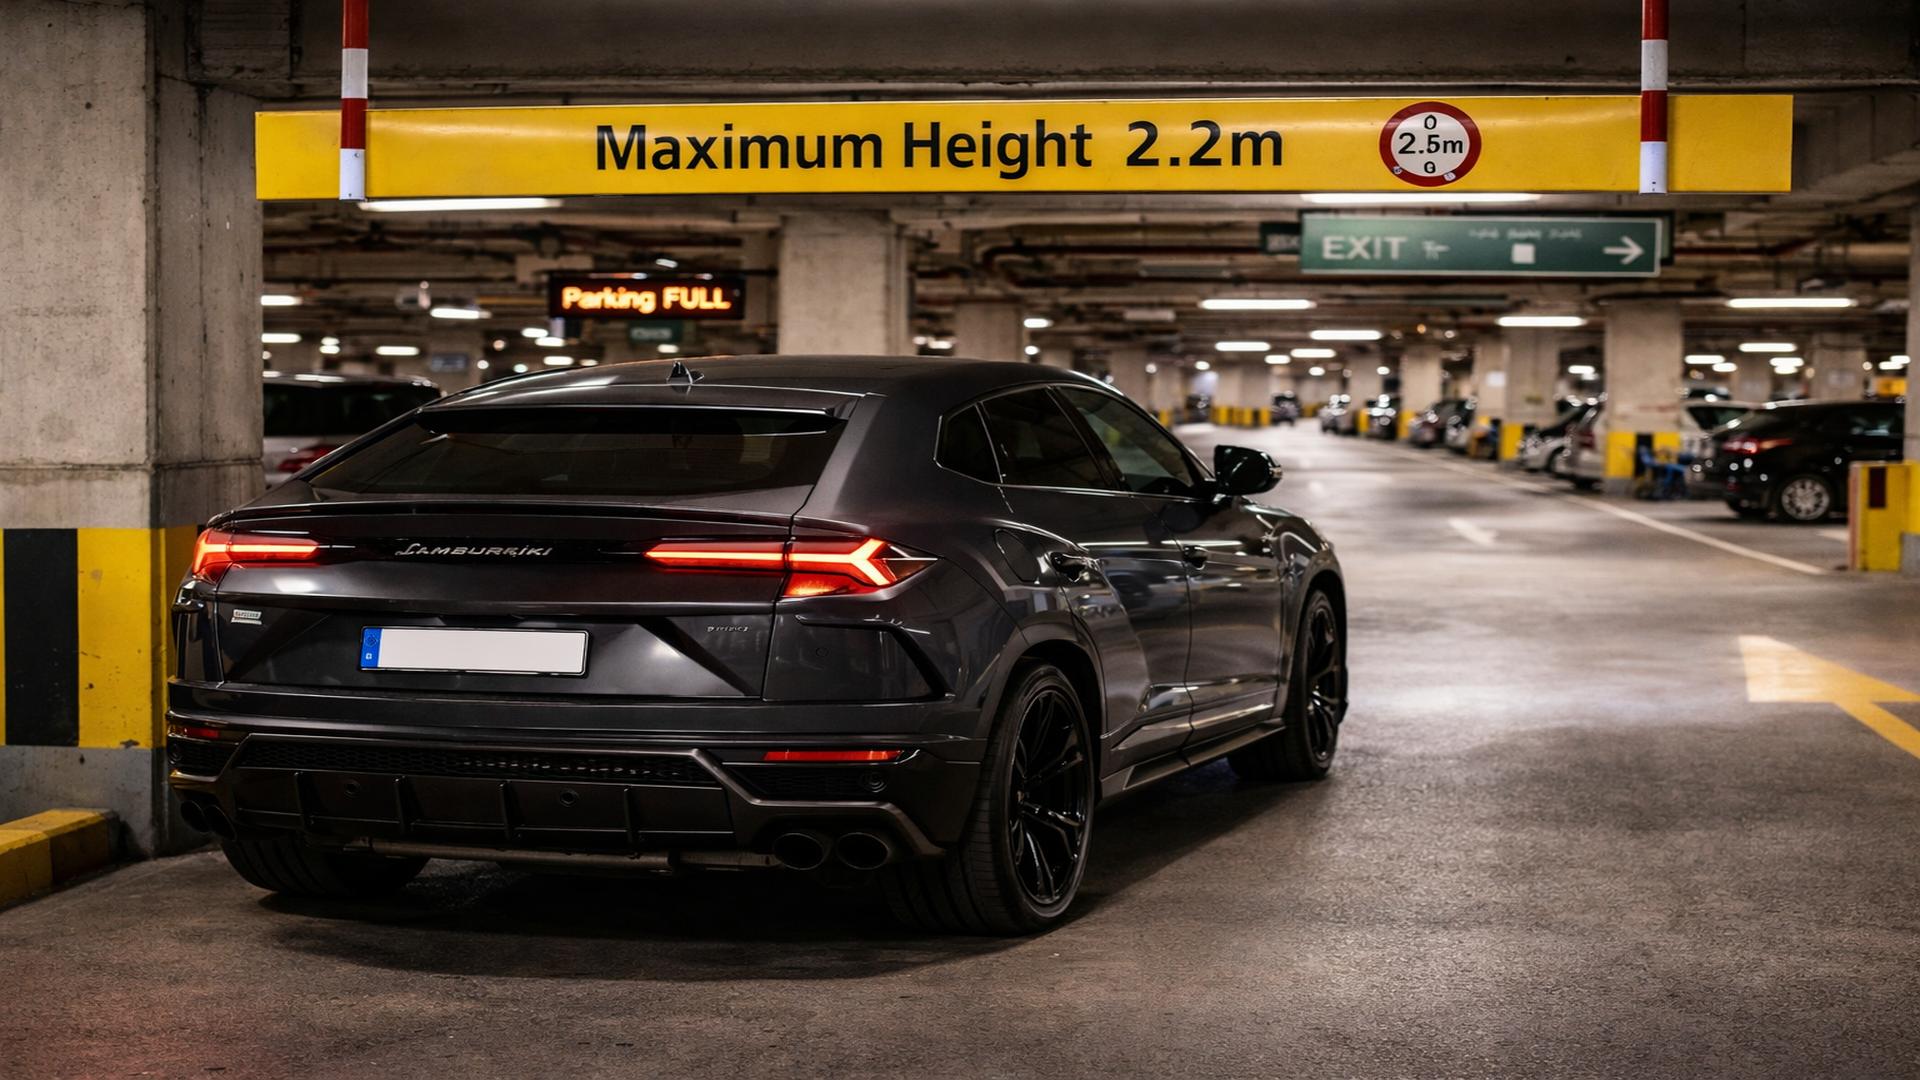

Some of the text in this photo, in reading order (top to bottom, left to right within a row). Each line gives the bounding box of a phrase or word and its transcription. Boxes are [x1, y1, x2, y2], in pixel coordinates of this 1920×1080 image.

[596, 119, 1283, 179] Maximum Height 2.2m
[1398, 132, 1463, 154] 2.5m
[1322, 236, 1408, 260] EXIT
[562, 286, 732, 314] Parking FULL
